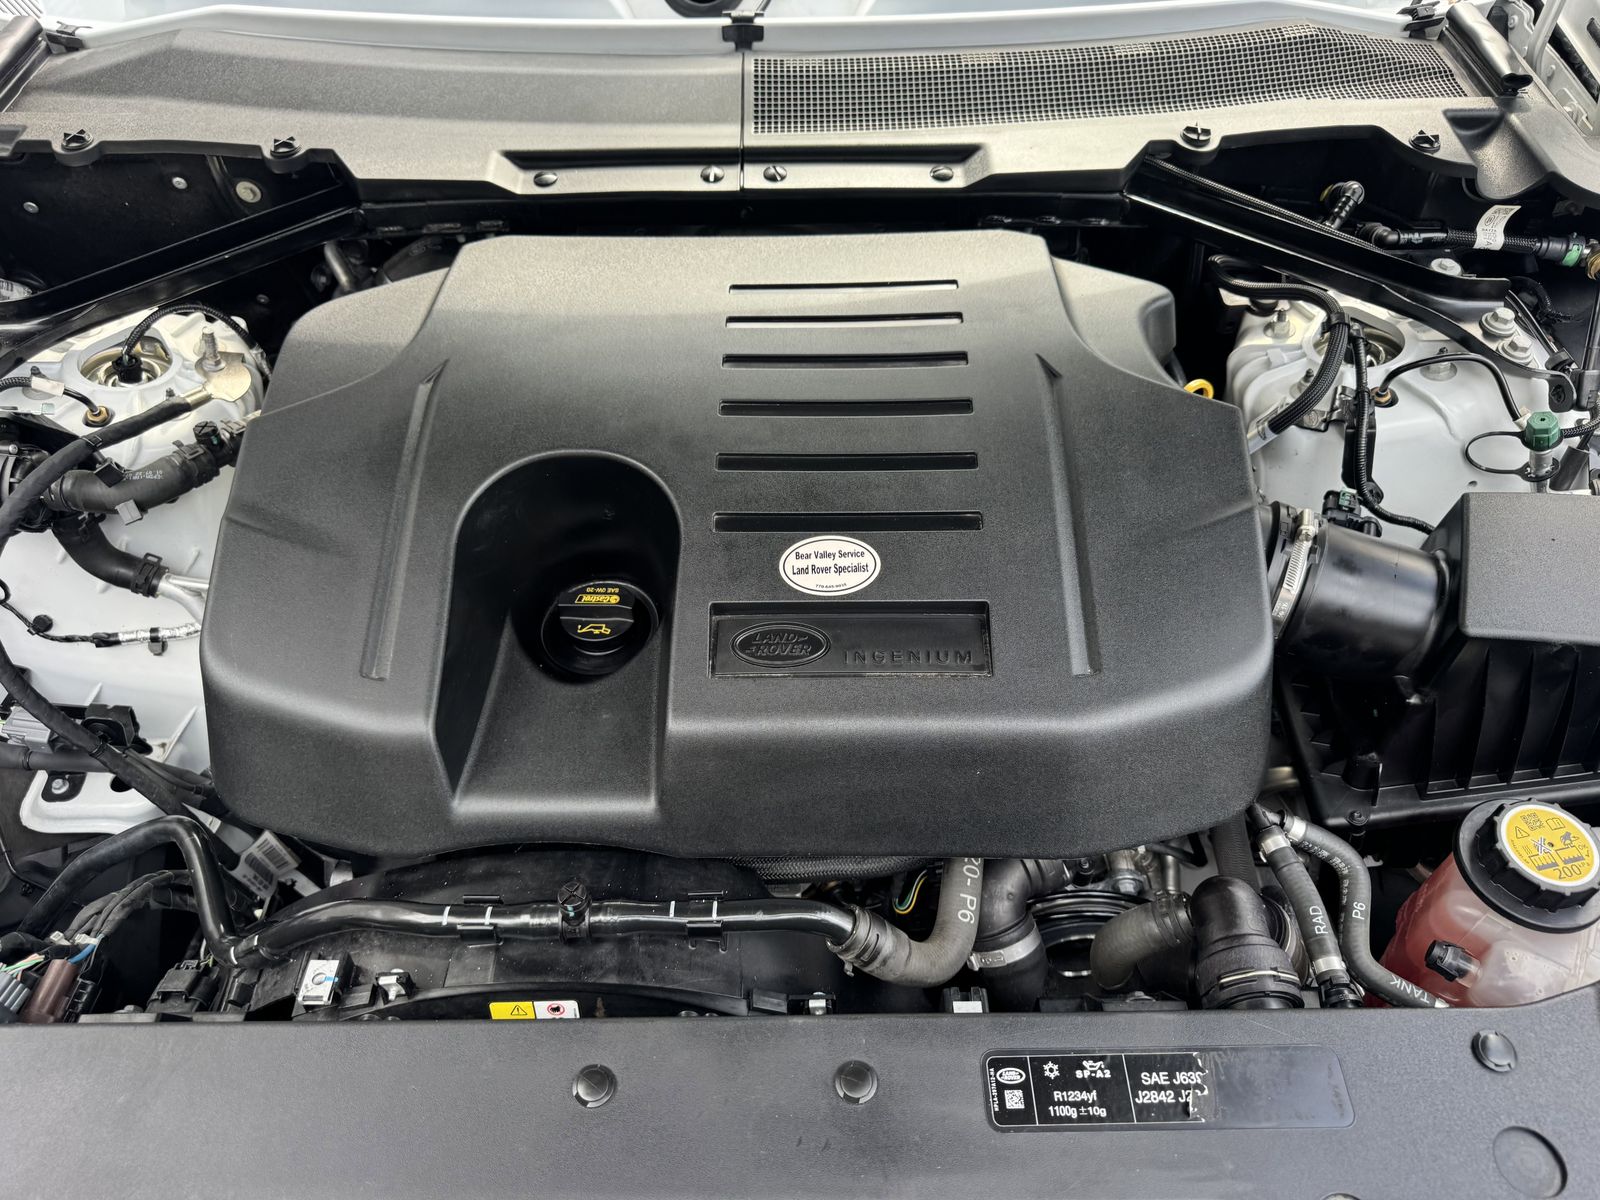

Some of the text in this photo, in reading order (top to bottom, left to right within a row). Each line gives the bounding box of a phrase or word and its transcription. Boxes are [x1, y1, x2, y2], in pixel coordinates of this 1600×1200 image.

[795, 549, 865, 560] Bear Valley Service
[792, 563, 869, 576] Land Rover Specialist
[582, 595, 611, 603] Castrol
[752, 633, 800, 644] LAND
[756, 645, 812, 656] ROVER
[843, 650, 973, 666] INGENIUM
[1553, 863, 1582, 880] 200
[958, 893, 977, 924] P6
[1352, 902, 1366, 920] P6
[1310, 905, 1328, 935] RAD
[1390, 974, 1430, 1004] TANK
[1075, 1070, 1112, 1078] SP-A2
[1140, 1072, 1170, 1085] SAE
[1053, 1090, 1098, 1104] R1234yf
[1134, 1090, 1176, 1104] J2842
[1048, 1106, 1078, 1118] 1100g
